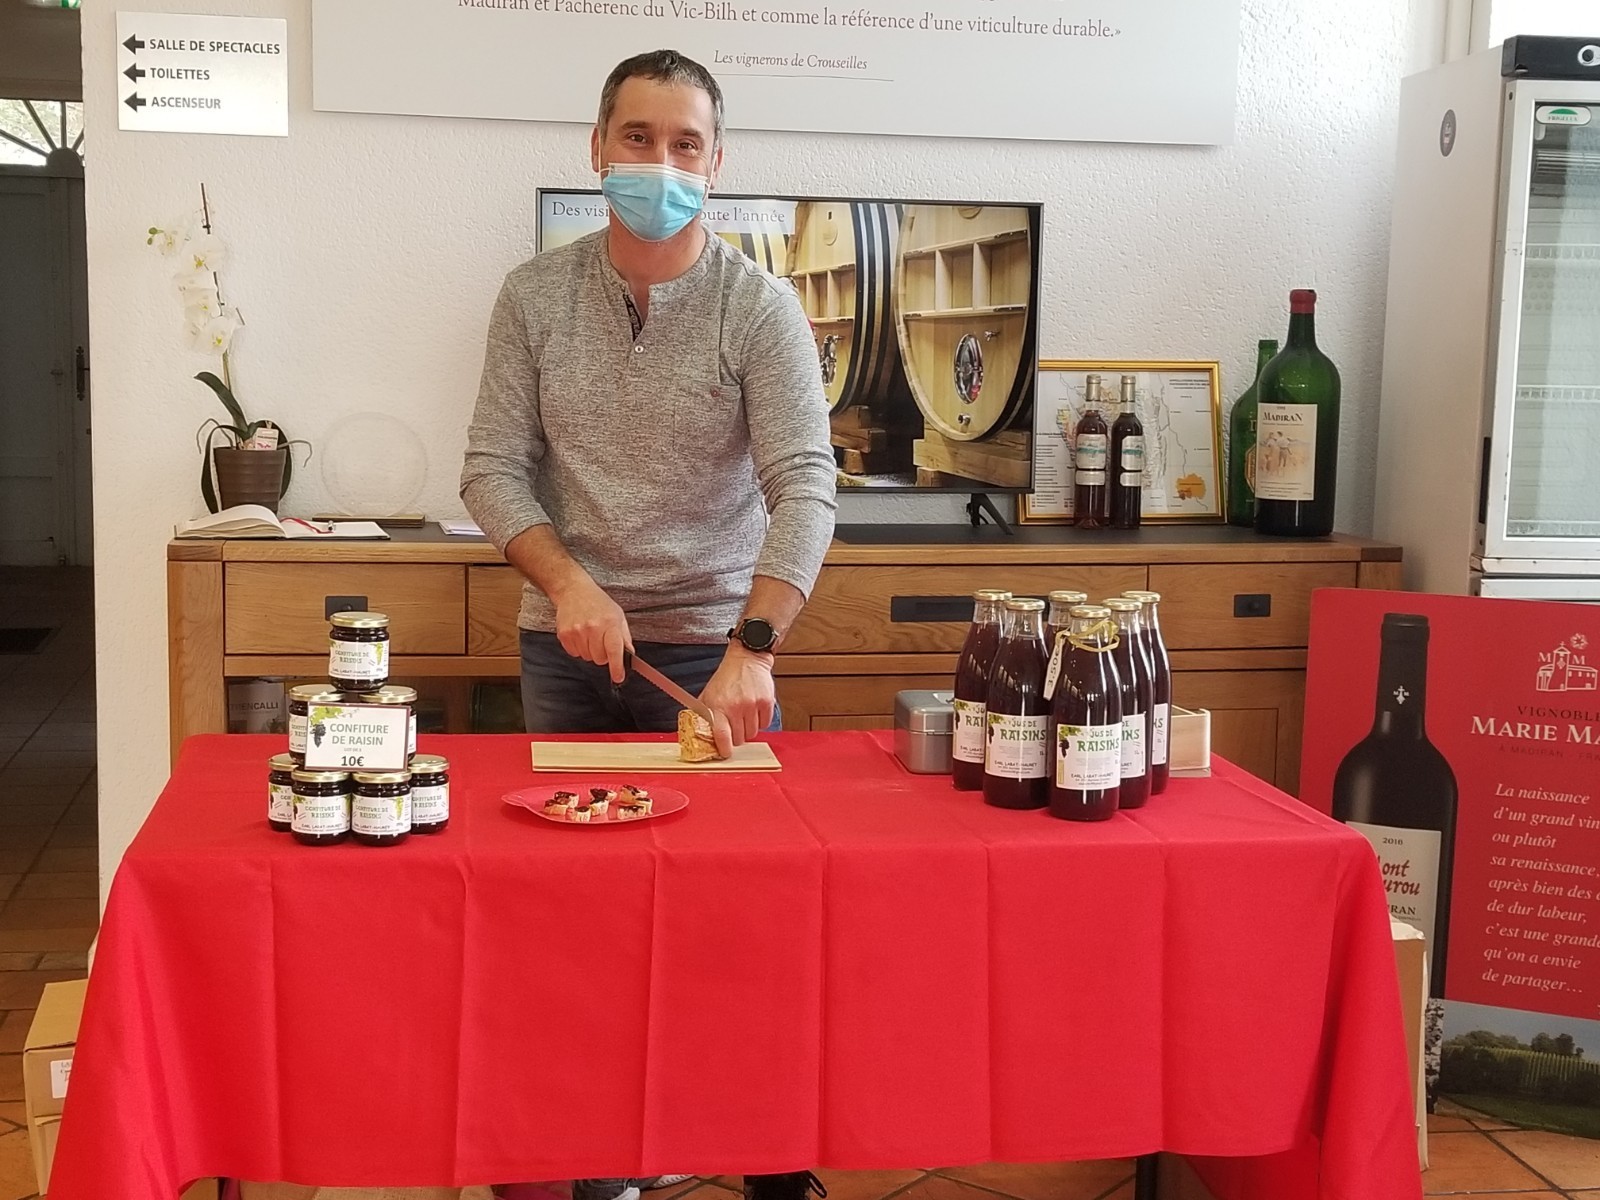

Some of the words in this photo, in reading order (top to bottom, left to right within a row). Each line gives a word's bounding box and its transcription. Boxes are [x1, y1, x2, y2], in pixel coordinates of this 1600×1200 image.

[554, 0, 640, 16] Pacherenc
[643, 0, 665, 18] du
[670, 1, 738, 21] Vic-Bilh
[742, 9, 758, 22] et
[760, 11, 820, 26] comme
[823, 7, 838, 26] la
[841, 9, 915, 29] référence
[919, 12, 964, 31] d'une
[968, 16, 1049, 35] viticulture
[150, 38, 185, 51] SALLE
[190, 40, 205, 52] DE
[209, 41, 281, 55] SPECTACLES
[714, 49, 734, 64] Les
[736, 51, 788, 68] vignerons
[790, 53, 804, 67] de
[806, 54, 868, 70] Crouseilles
[150, 67, 210, 81] TOILETTES
[151, 96, 221, 110] ASCENSEUR
[552, 201, 581, 217] Des
[584, 202, 610, 217] visi
[700, 208, 730, 222] oute
[733, 207, 786, 223] l'année
[1538, 652, 1552, 663] M
[1572, 655, 1586, 665] M
[330, 723, 389, 735] CONFITURE
[1000, 728, 1046, 741] RAISINS
[1091, 728, 1104, 738] JUS
[1106, 729, 1113, 737] DE
[1121, 729, 1140, 741] INS
[1471, 716, 1558, 741] MARIE
[332, 735, 346, 745] DE
[348, 736, 383, 746] RAISIN
[1077, 738, 1120, 752] RAISINS
[341, 755, 365, 767] 10€
[1495, 783, 1514, 797] La
[1518, 787, 1590, 804] naissance
[1493, 806, 1526, 822] d'un
[1529, 814, 1575, 827] grand
[1382, 837, 1404, 846] 2016
[1492, 831, 1510, 844] ou
[1512, 832, 1557, 848] plutôt
[1378, 855, 1410, 877] ont
[1490, 855, 1507, 867] sa
[1383, 879, 1420, 896] urou
[1488, 878, 1529, 893] après
[1532, 880, 1564, 896] bien
[1567, 884, 1593, 900] des
[1388, 904, 1416, 916] RAN
[1487, 899, 1505, 913] de
[1508, 901, 1534, 916] dur
[1537, 904, 1587, 925] labeur,
[1485, 922, 1520, 938] c'est
[1523, 929, 1550, 942] une
[1483, 947, 1526, 963] qu'on
[1528, 954, 1539, 965] a
[1542, 956, 1582, 969] envie
[1482, 968, 1500, 982] de
